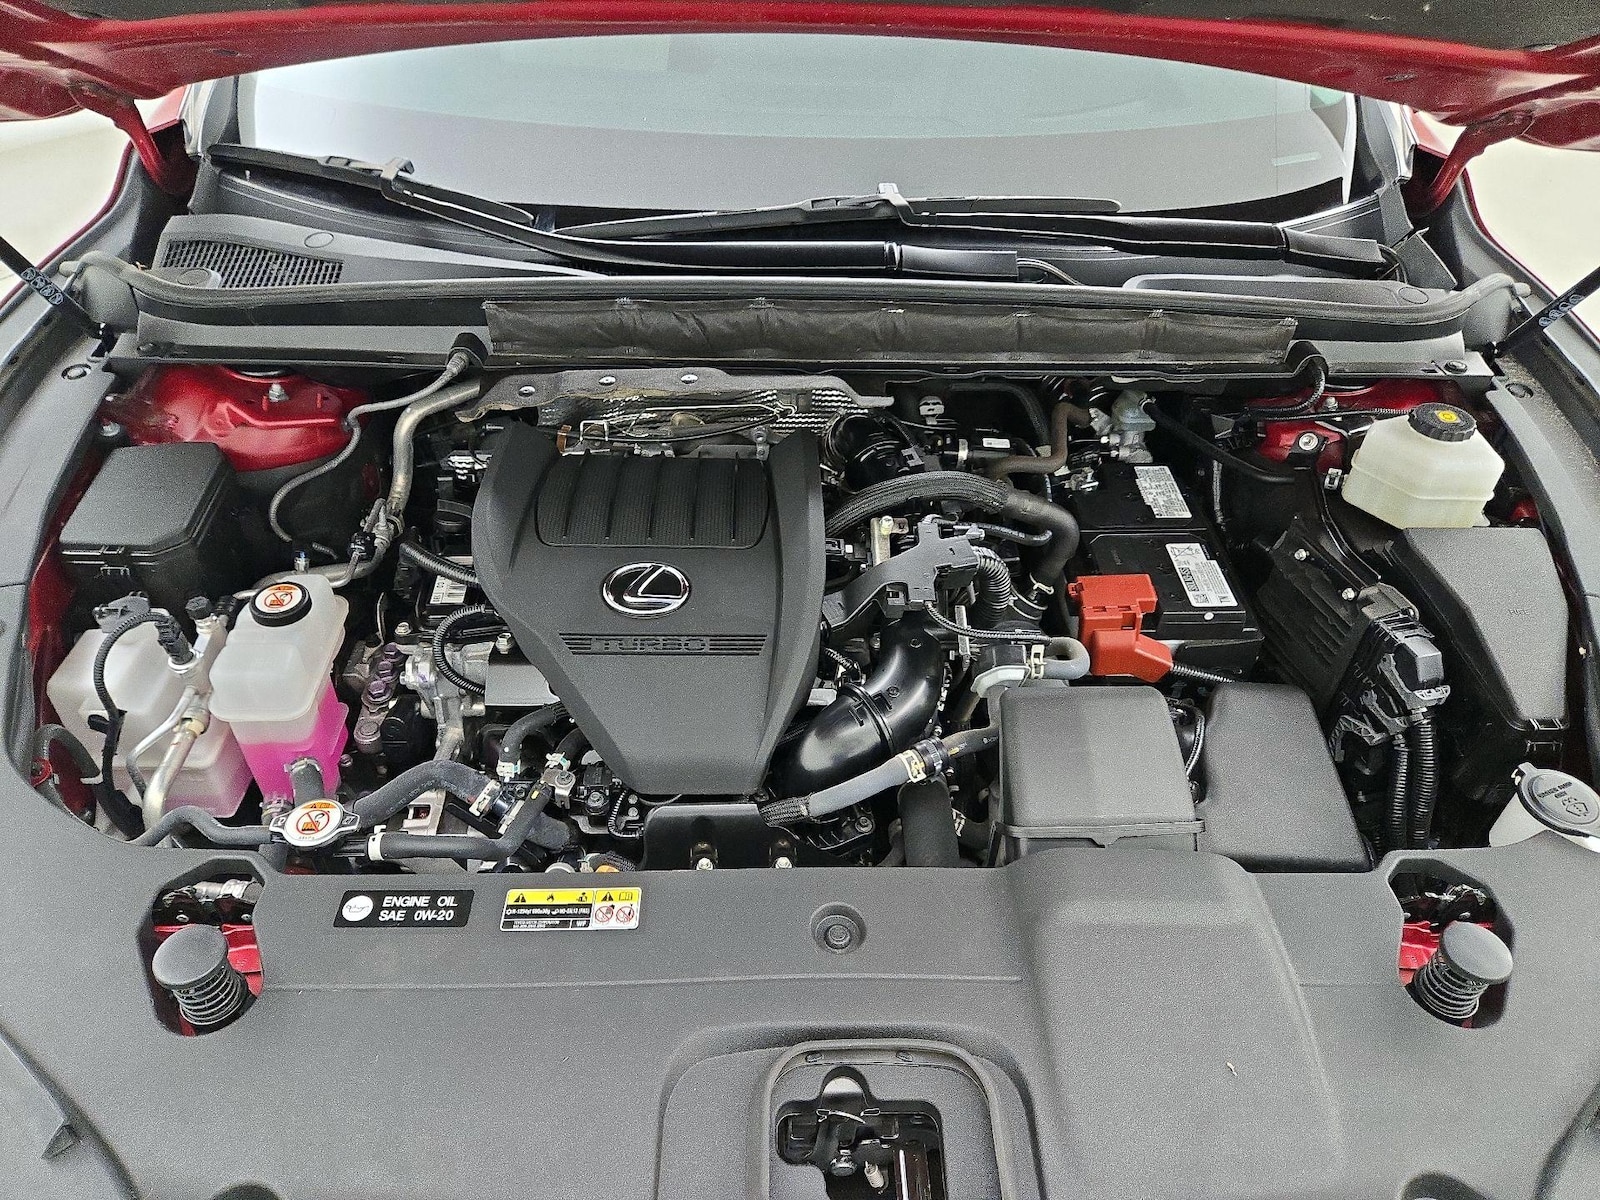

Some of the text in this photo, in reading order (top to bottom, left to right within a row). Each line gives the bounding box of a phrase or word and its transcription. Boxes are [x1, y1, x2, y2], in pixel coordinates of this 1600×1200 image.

[596, 637, 706, 651] TURBO
[382, 896, 459, 907] ENGINE OIL
[378, 910, 455, 921] SAE 0W-20
